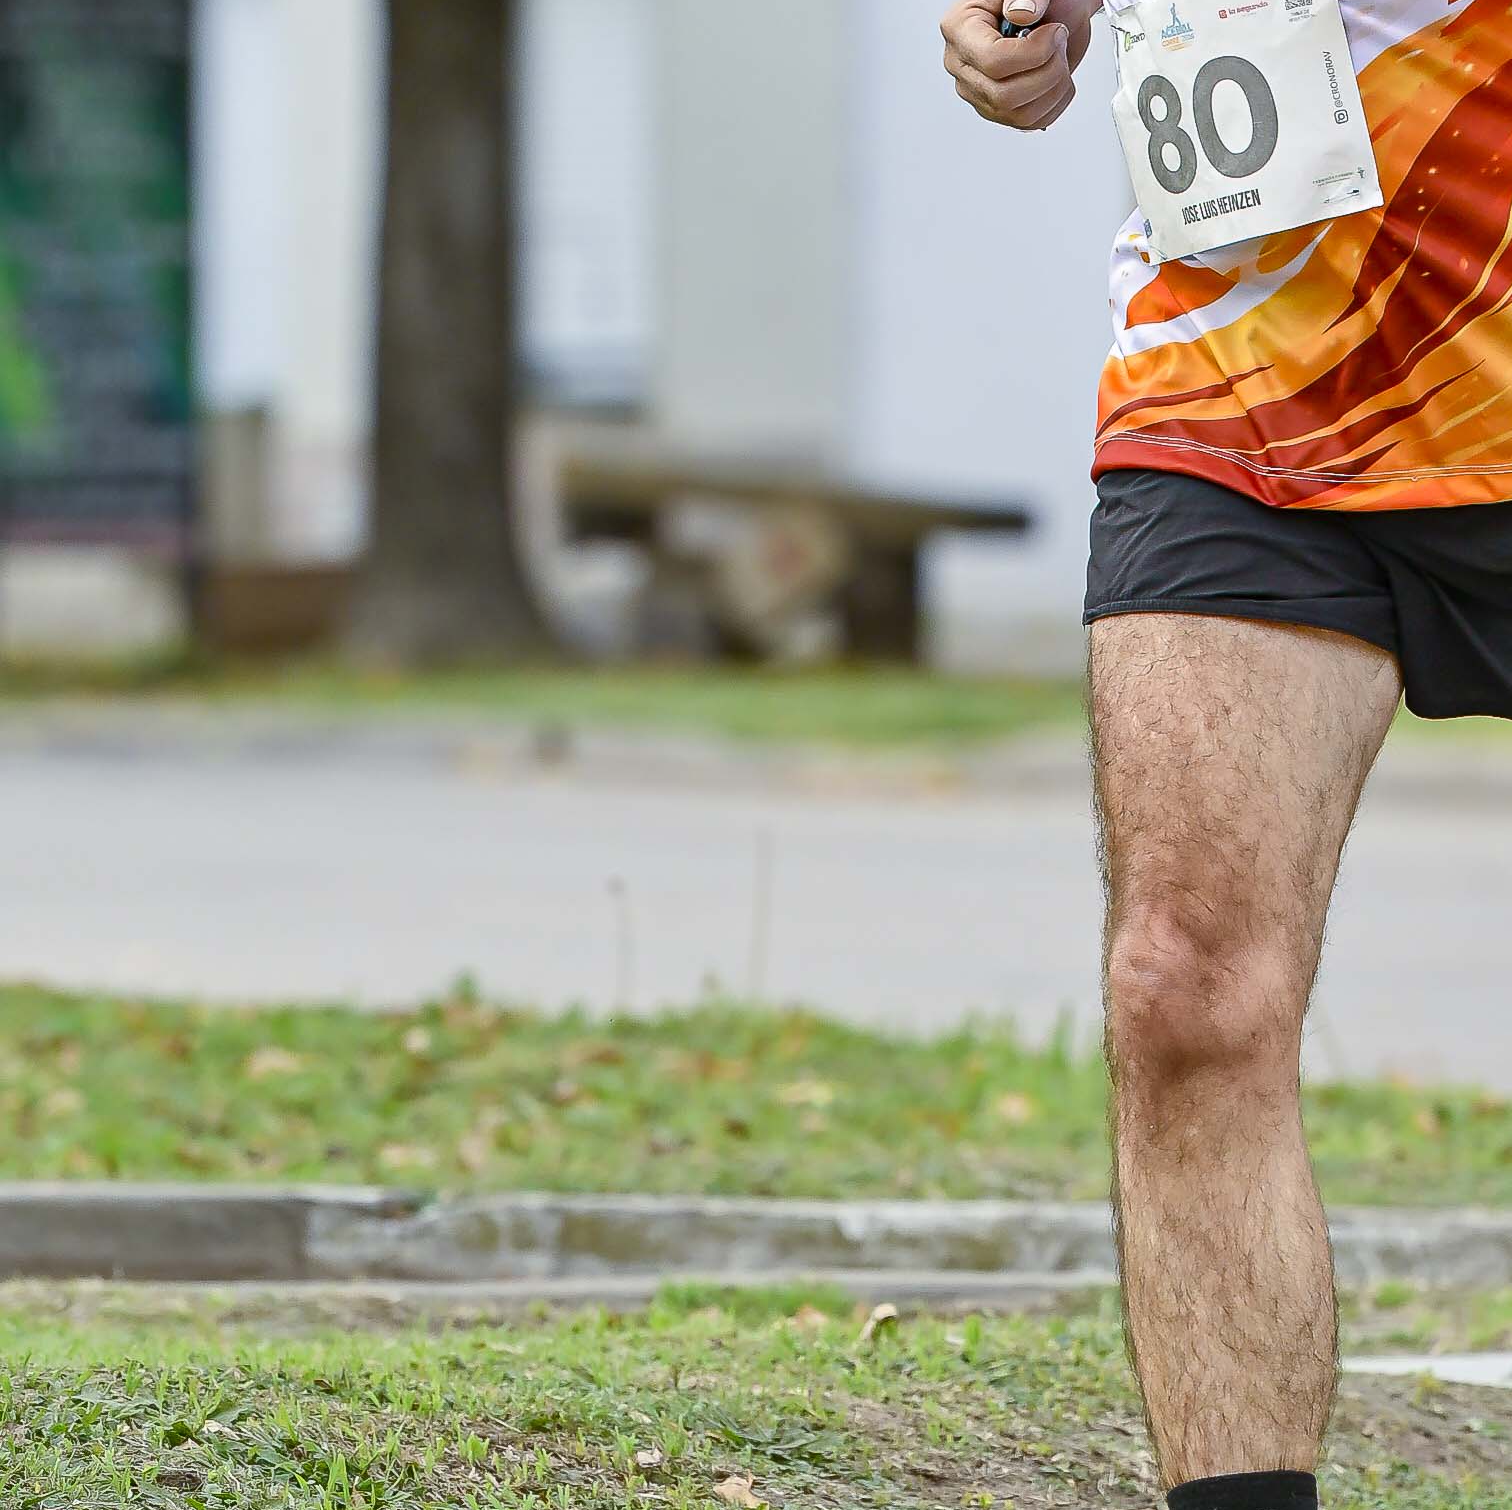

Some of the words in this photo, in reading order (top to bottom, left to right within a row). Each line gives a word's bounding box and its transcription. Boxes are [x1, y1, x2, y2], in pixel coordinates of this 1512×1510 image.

[1138, 56, 1278, 194] 80
[1182, 205, 1201, 225] JOSE
[1199, 200, 1218, 220] LUIS
[1217, 189, 1261, 215] HEINZEN
